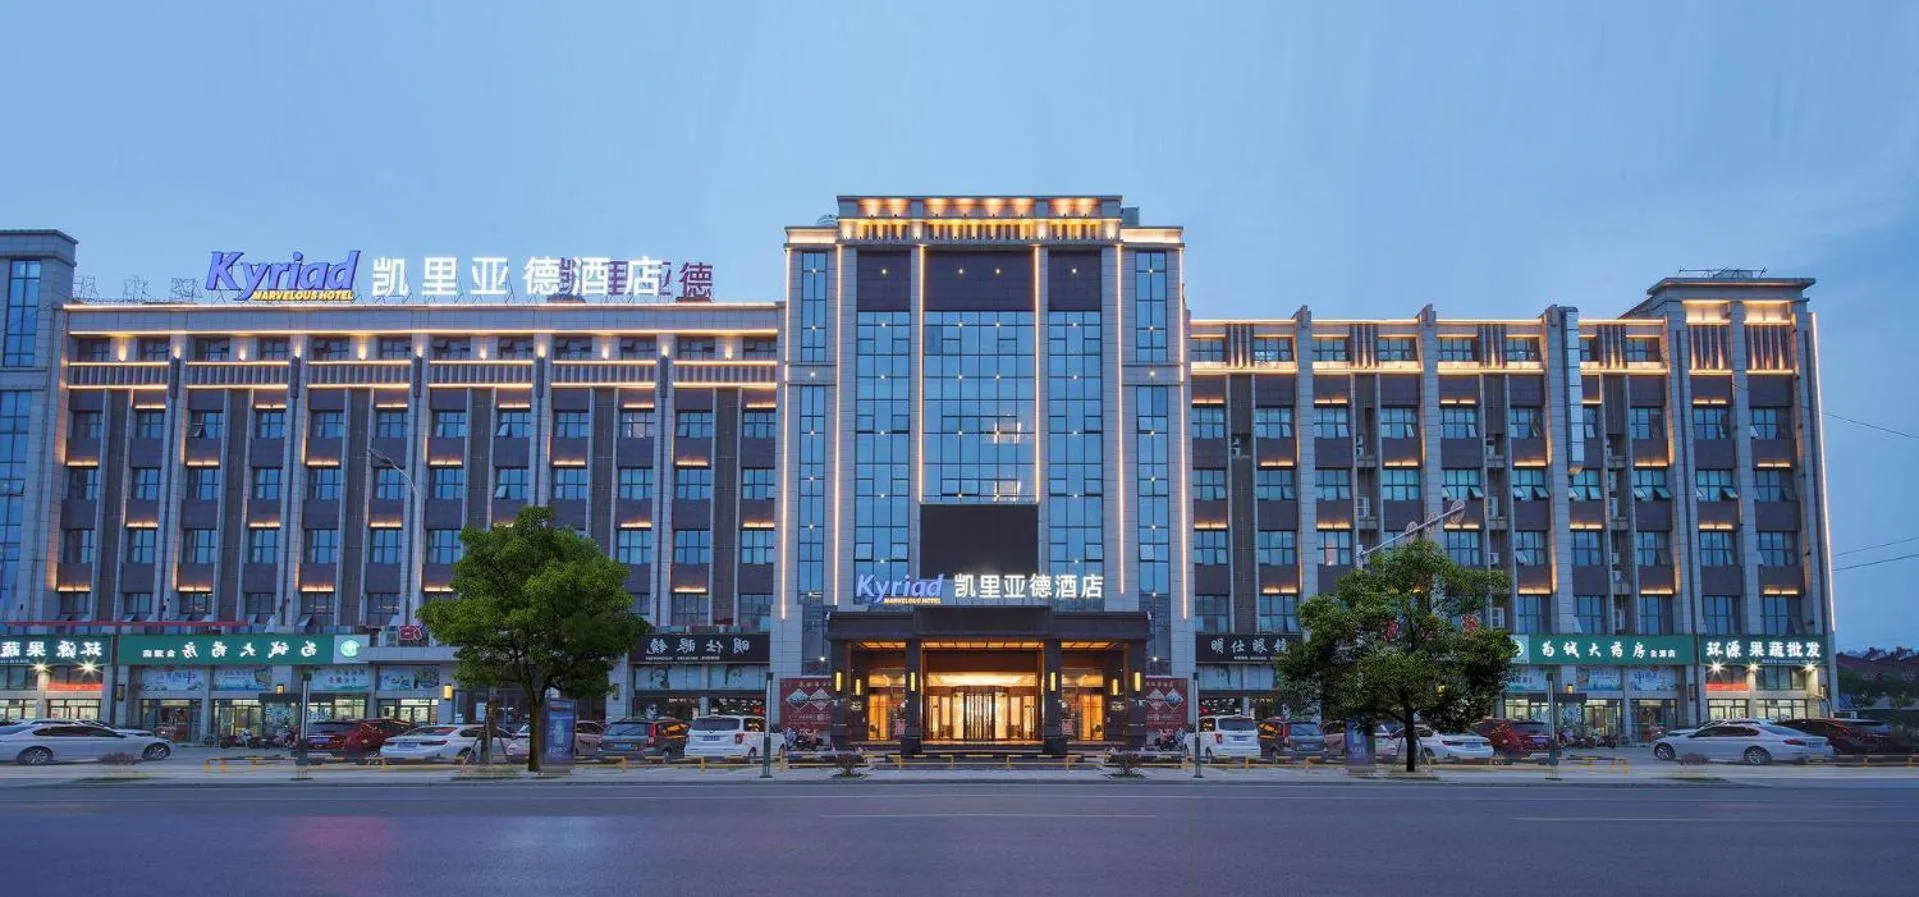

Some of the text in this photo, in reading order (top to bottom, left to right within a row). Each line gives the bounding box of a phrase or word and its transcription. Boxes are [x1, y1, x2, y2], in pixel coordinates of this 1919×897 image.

[205, 250, 361, 301] Kyriad
[372, 256, 663, 297] 凯里亚德酒店
[253, 290, 354, 301] MARVELOUS HOTEL
[855, 573, 944, 603] Kyriad
[954, 573, 1104, 599] 凯里亚德酒店
